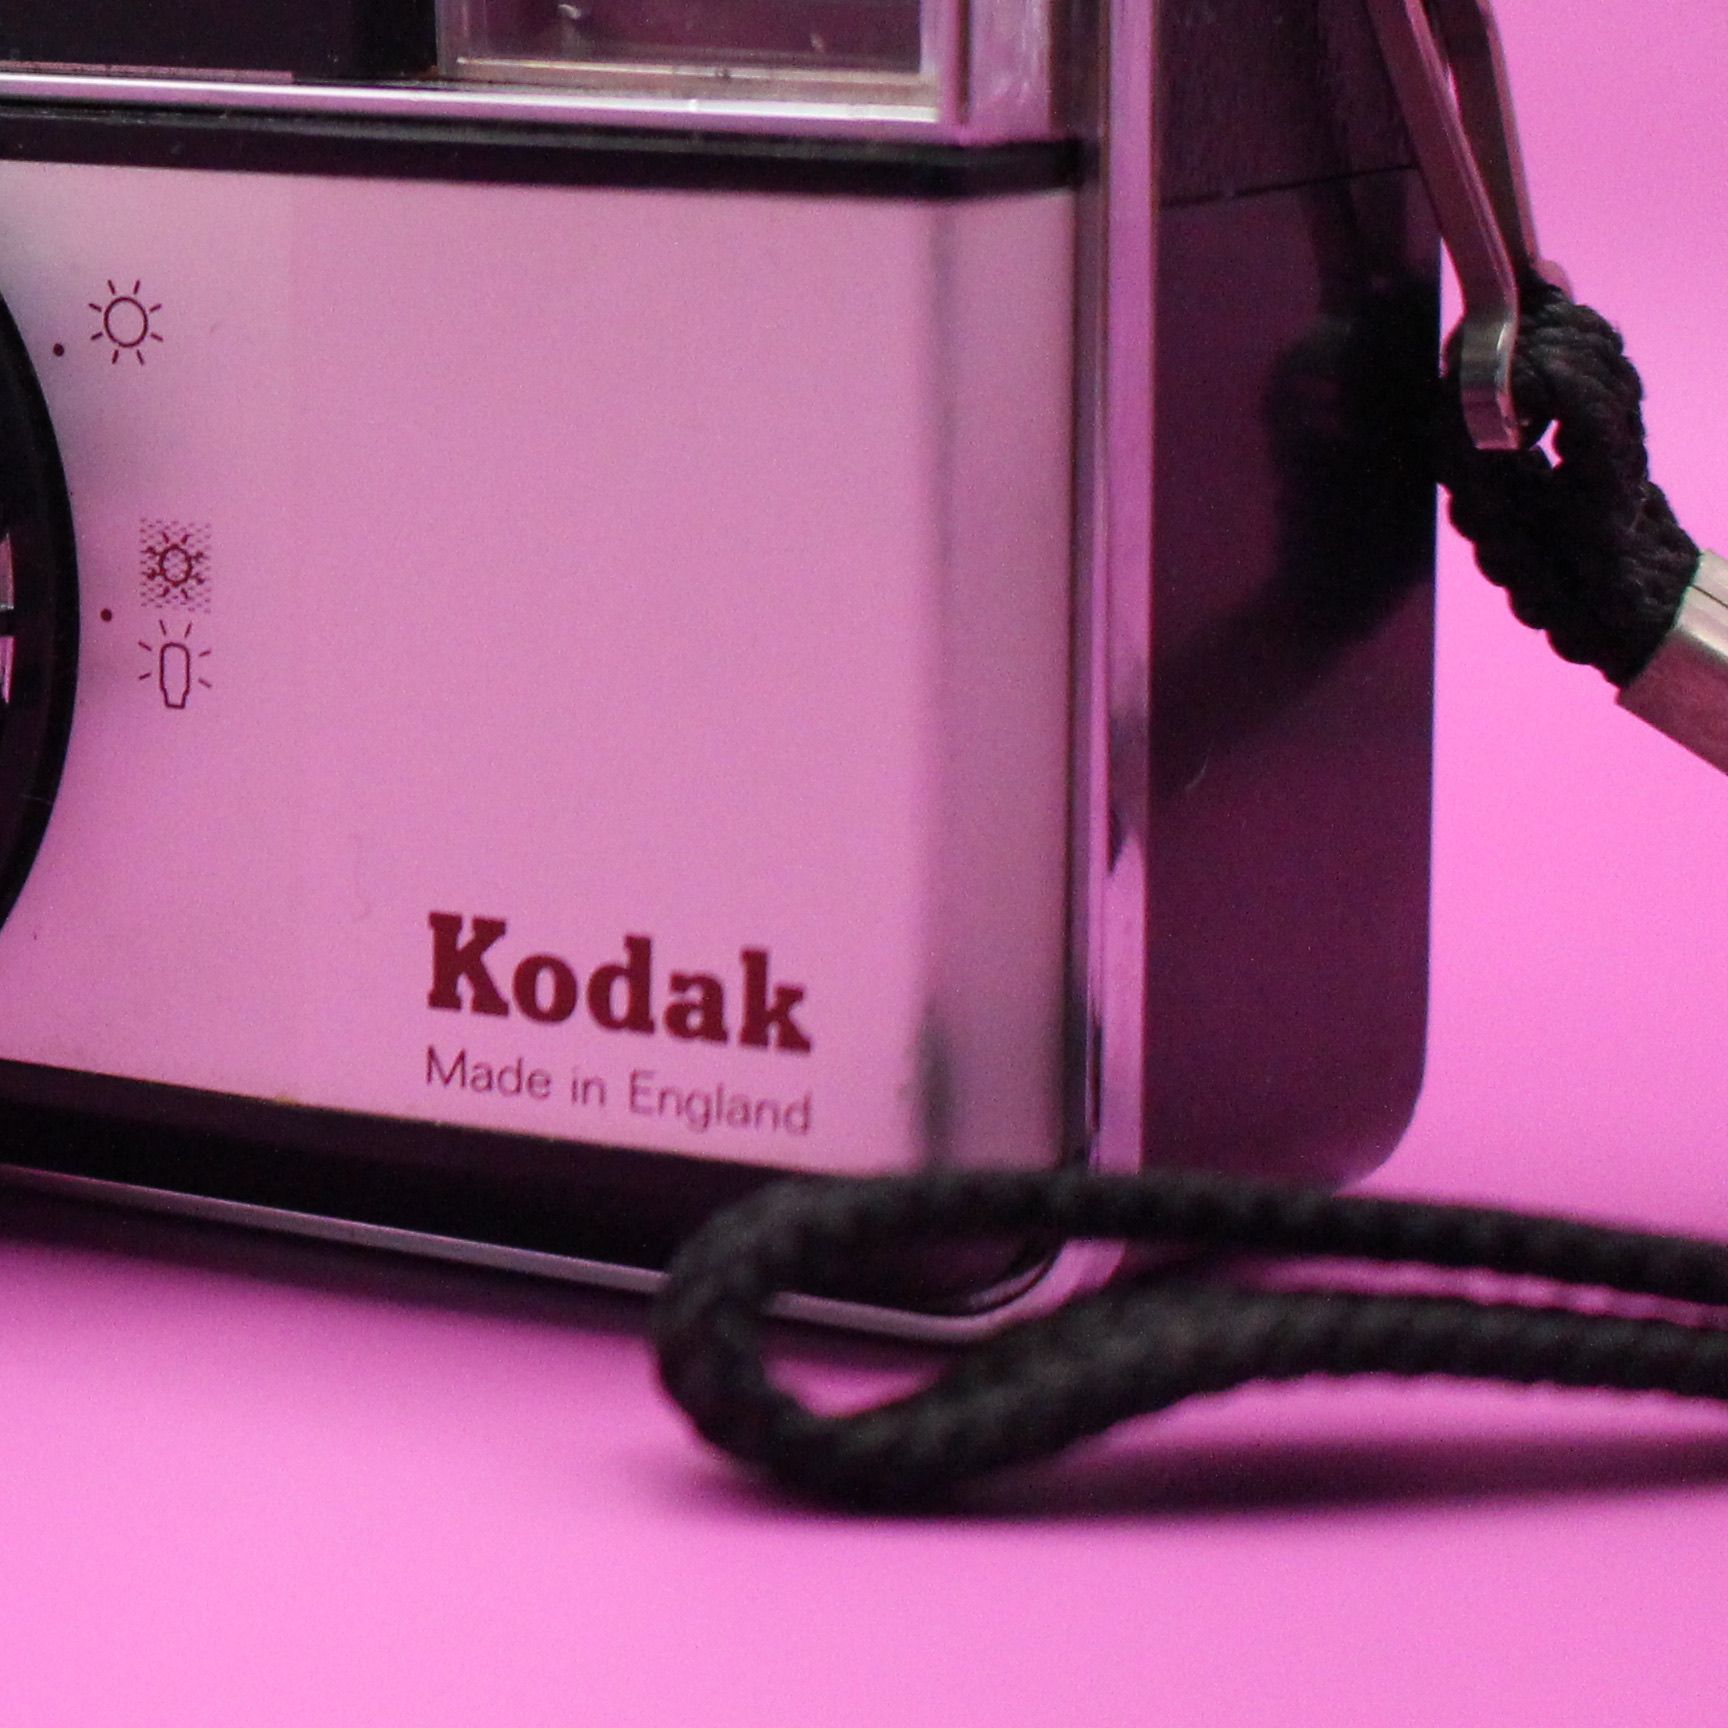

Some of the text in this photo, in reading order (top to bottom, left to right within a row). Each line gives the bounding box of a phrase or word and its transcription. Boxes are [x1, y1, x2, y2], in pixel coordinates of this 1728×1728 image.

[427, 911, 812, 1055] Kodak
[425, 1045, 812, 1135] Made in England
